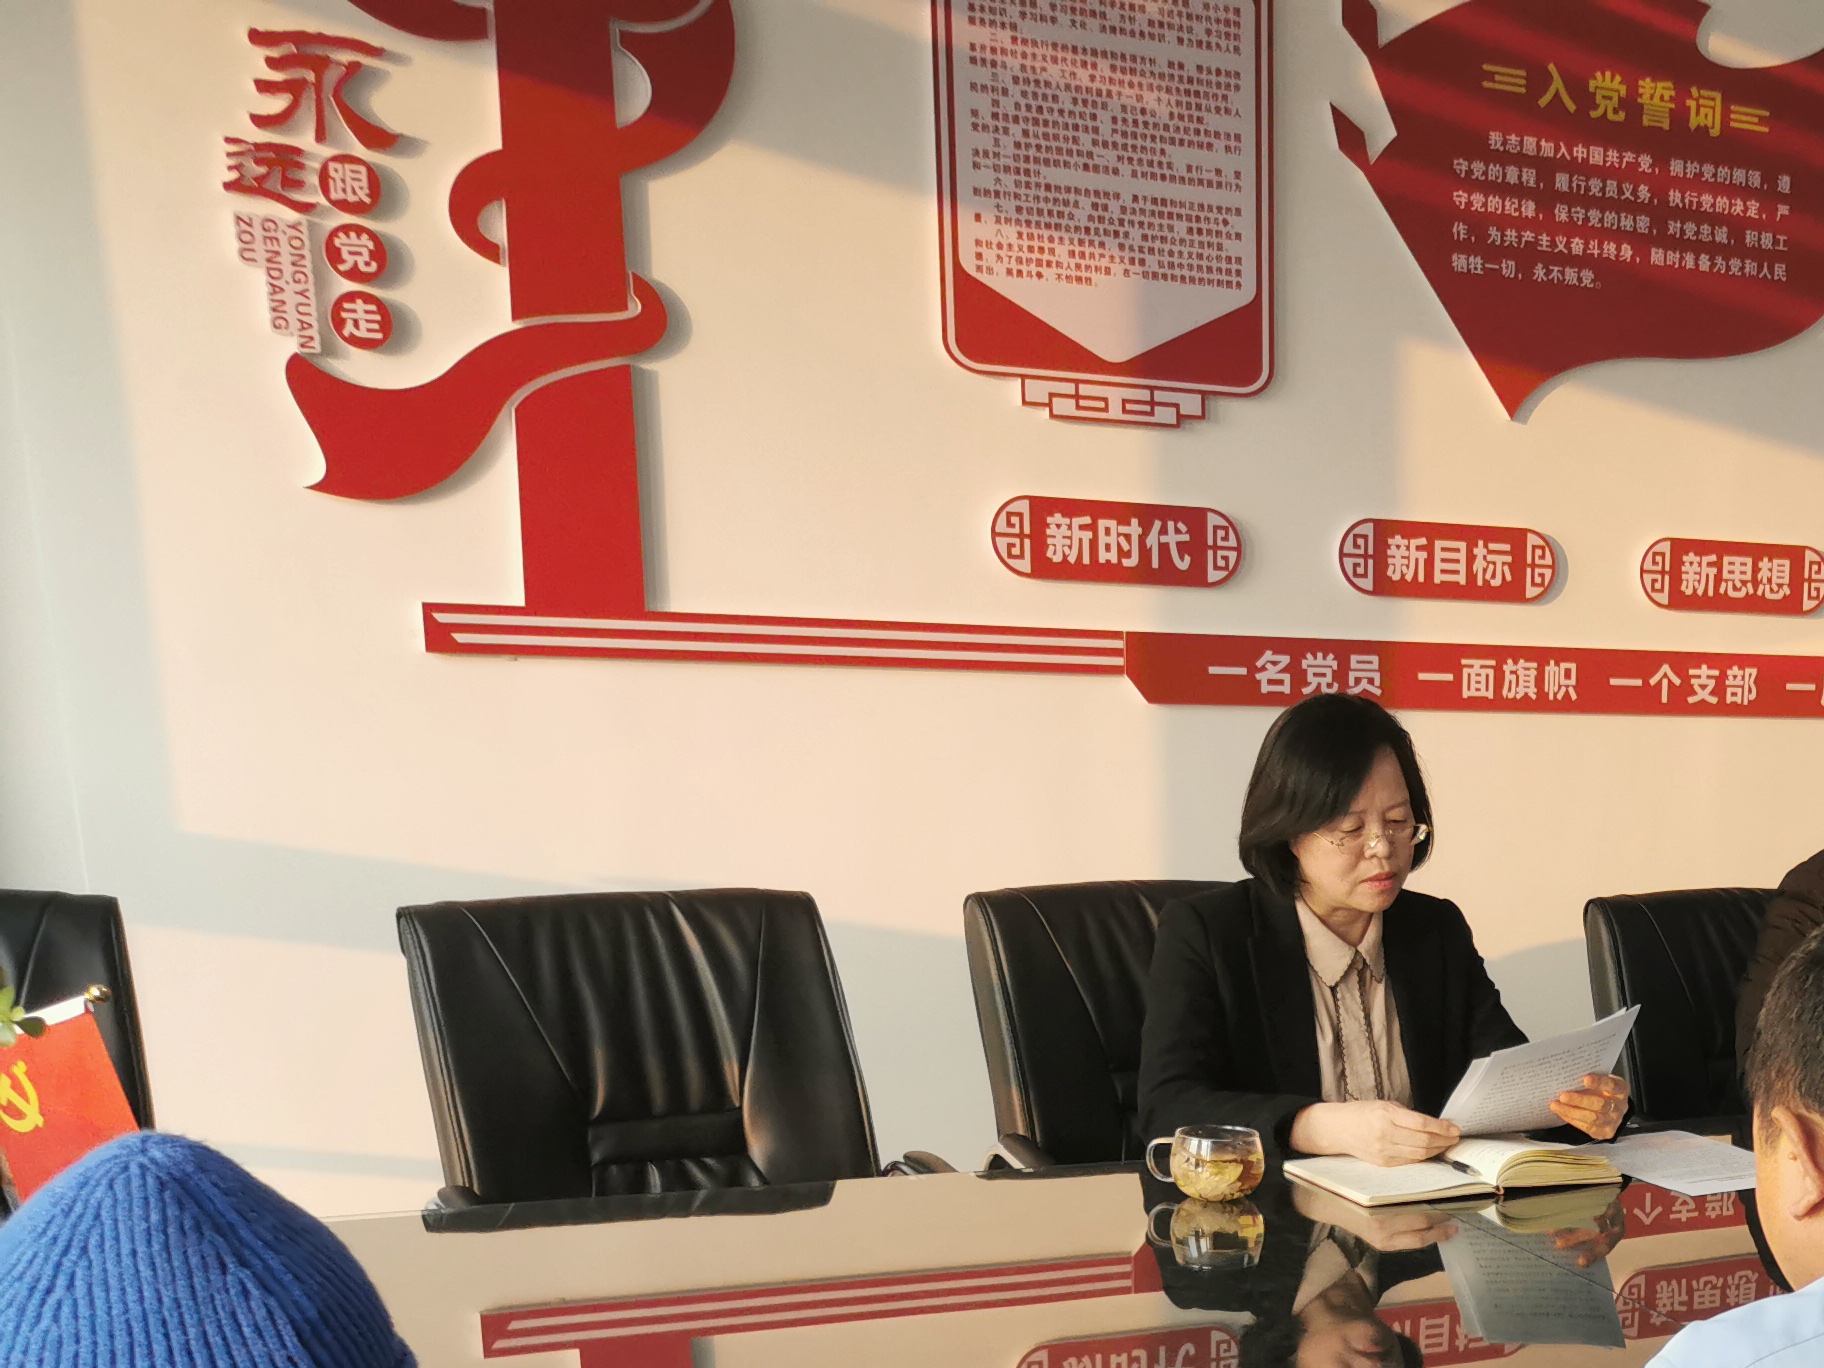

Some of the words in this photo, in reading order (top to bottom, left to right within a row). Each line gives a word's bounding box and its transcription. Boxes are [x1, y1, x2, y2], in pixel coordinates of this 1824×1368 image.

[222, 27, 401, 215] 永远
[1537, 63, 1722, 137] 入党誓词
[235, 214, 258, 263] ZOU
[327, 161, 384, 341] 跟党走
[261, 217, 289, 331] GENDANG
[286, 220, 316, 350] YONGYUAN
[1044, 512, 1192, 571] 新时代
[1385, 534, 1514, 588] 新目标
[1679, 552, 1792, 601] 新思想
[1207, 650, 1384, 697] 一名党员
[1417, 656, 1578, 701] 一面旗帜
[1608, 663, 1759, 705] 一个支部
